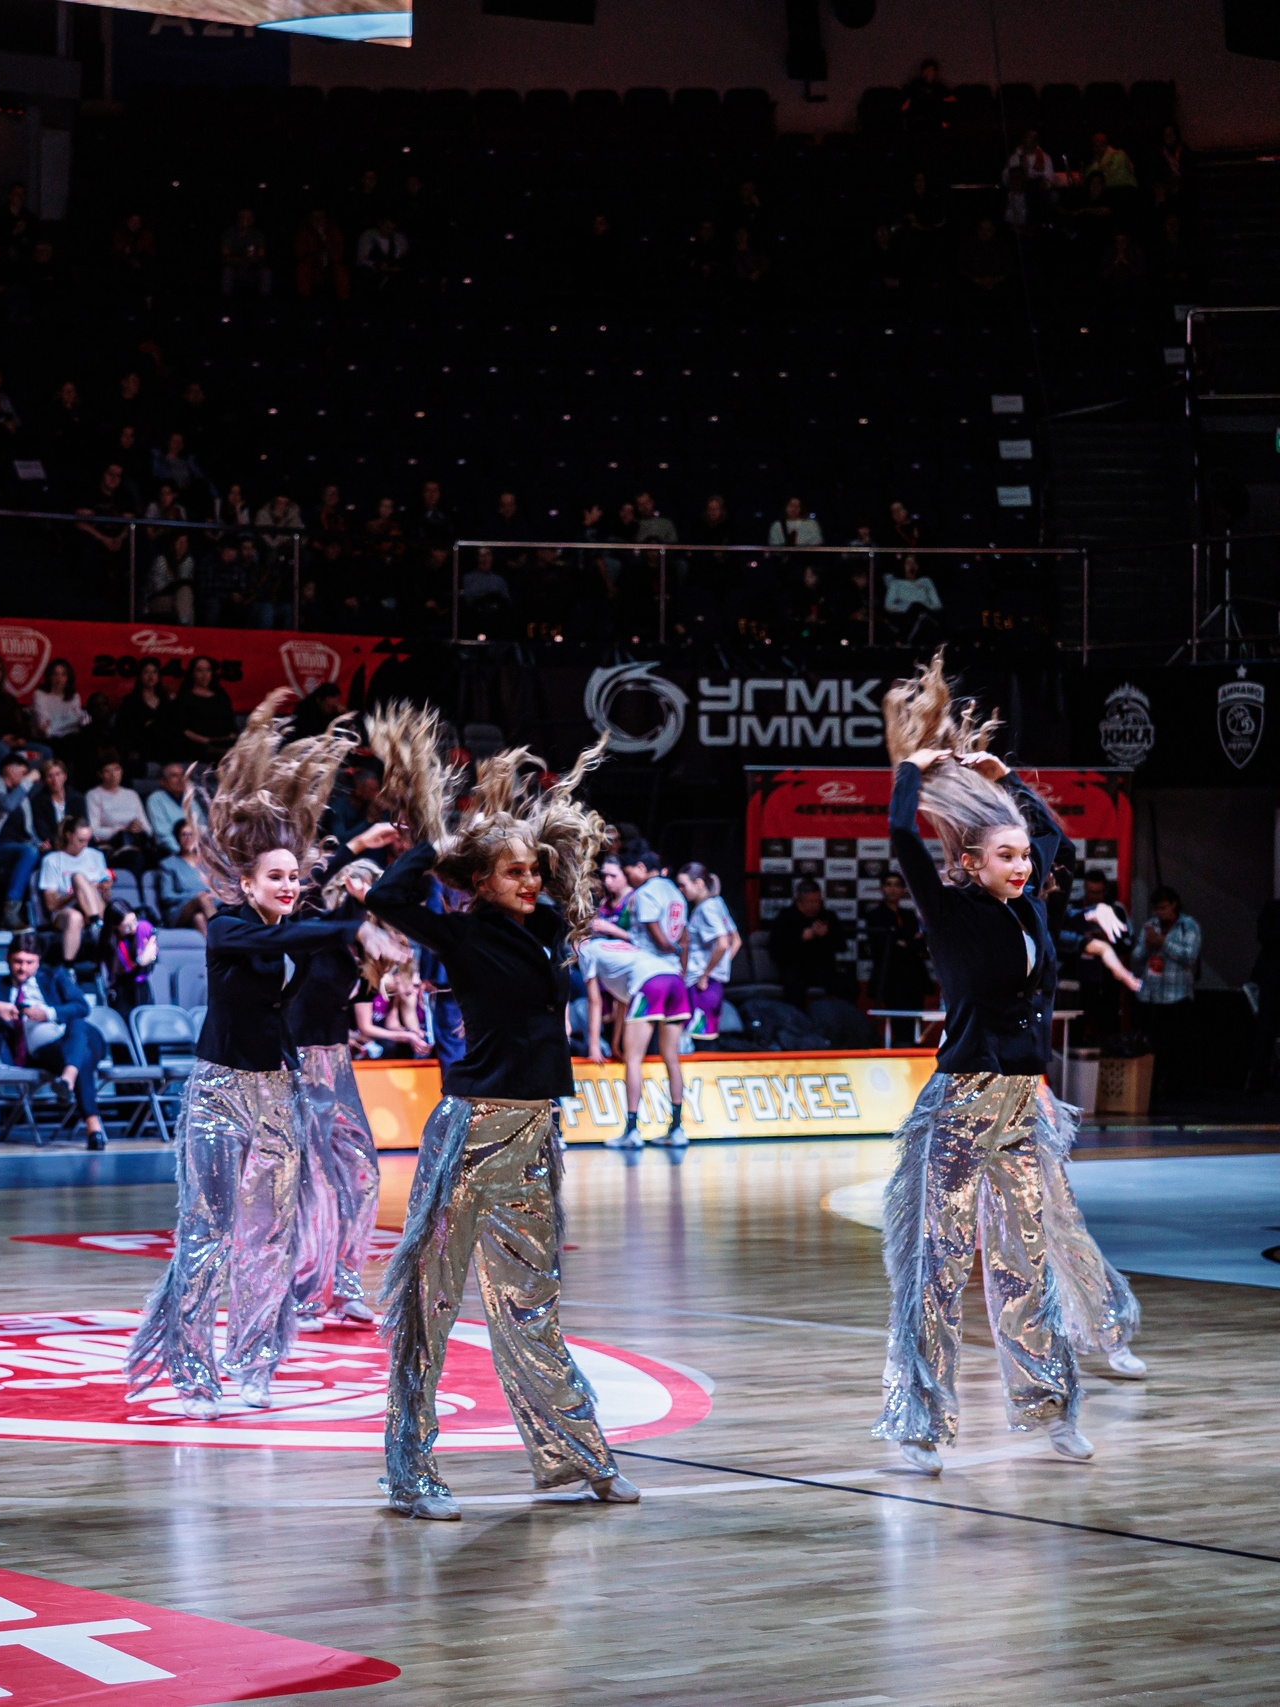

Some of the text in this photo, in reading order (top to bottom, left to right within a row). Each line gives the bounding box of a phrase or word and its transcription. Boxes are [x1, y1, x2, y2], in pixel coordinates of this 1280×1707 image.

[697, 676, 884, 713] УГМК
[697, 714, 885, 748] UMMC
[716, 1072, 862, 1121] FOXES
